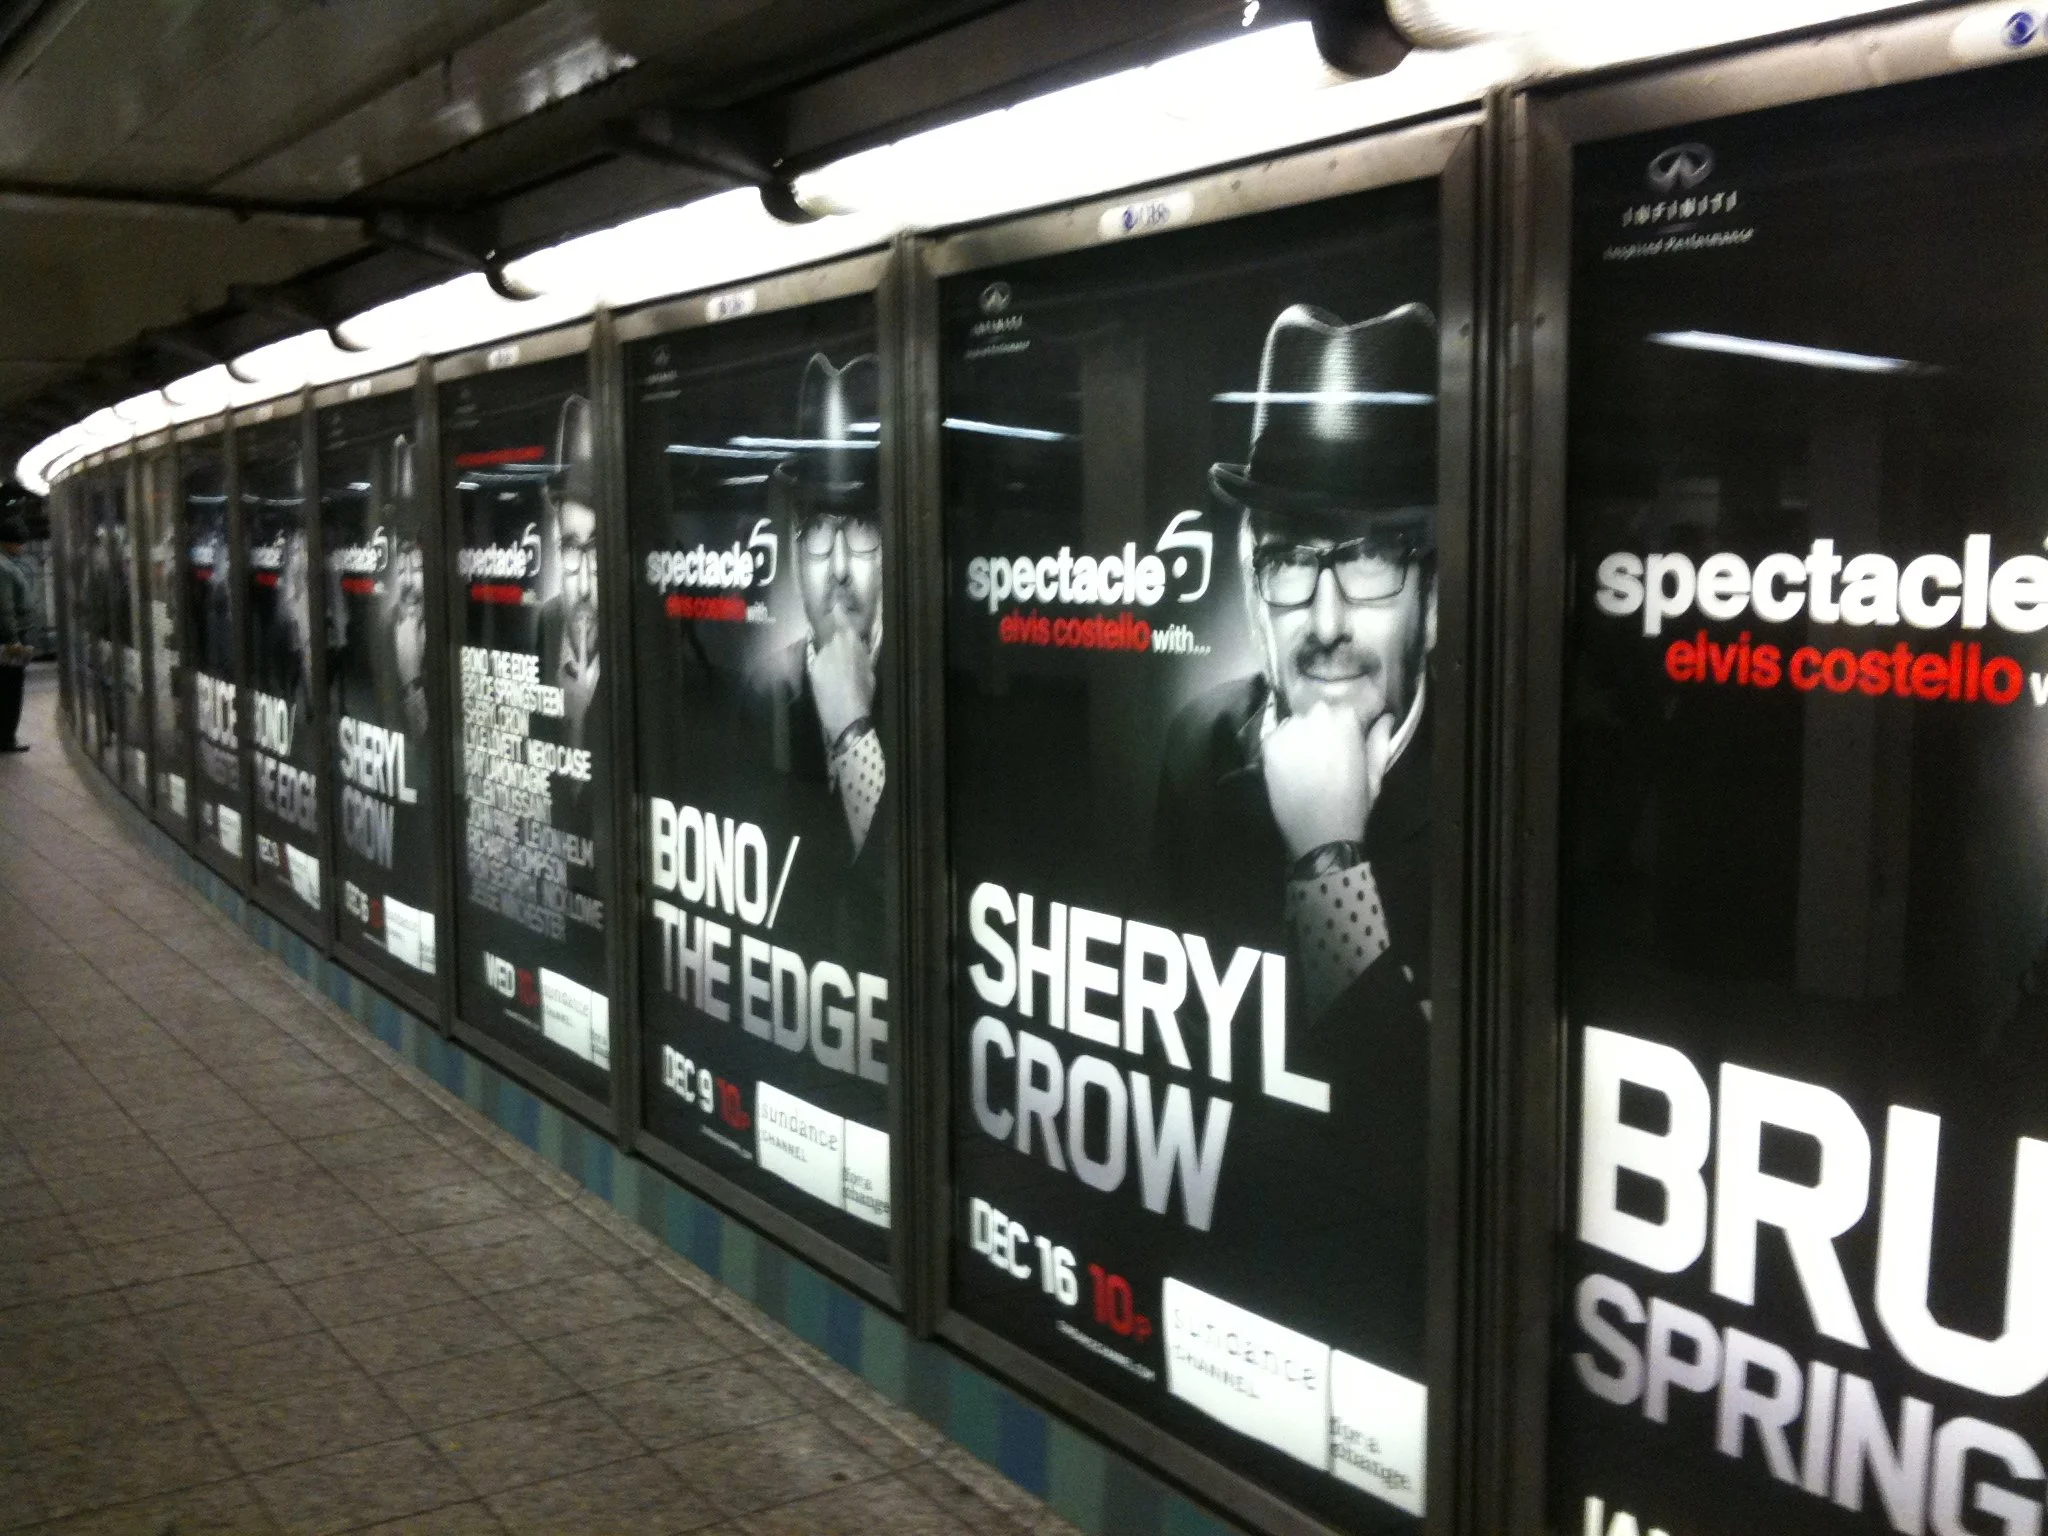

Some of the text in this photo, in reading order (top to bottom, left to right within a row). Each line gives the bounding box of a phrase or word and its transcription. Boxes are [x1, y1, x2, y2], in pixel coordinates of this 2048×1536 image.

[645, 538, 755, 594] spectacle
[967, 543, 1166, 614] spectacle
[1596, 534, 2048, 637] spectacle
[1001, 609, 1050, 646] elvis
[1053, 613, 1151, 653] costello
[1665, 632, 1782, 689] elvis
[1790, 640, 2024, 706] costello
[652, 899, 731, 1023] THE
[741, 934, 889, 1085] EDGE
[969, 882, 1330, 1113] SHERYL
[662, 1044, 695, 1103] DEC
[697, 1068, 714, 1114] 9
[969, 1015, 1233, 1232] CROW
[970, 1197, 1031, 1280] DEC
[1034, 1235, 1079, 1307] 16
